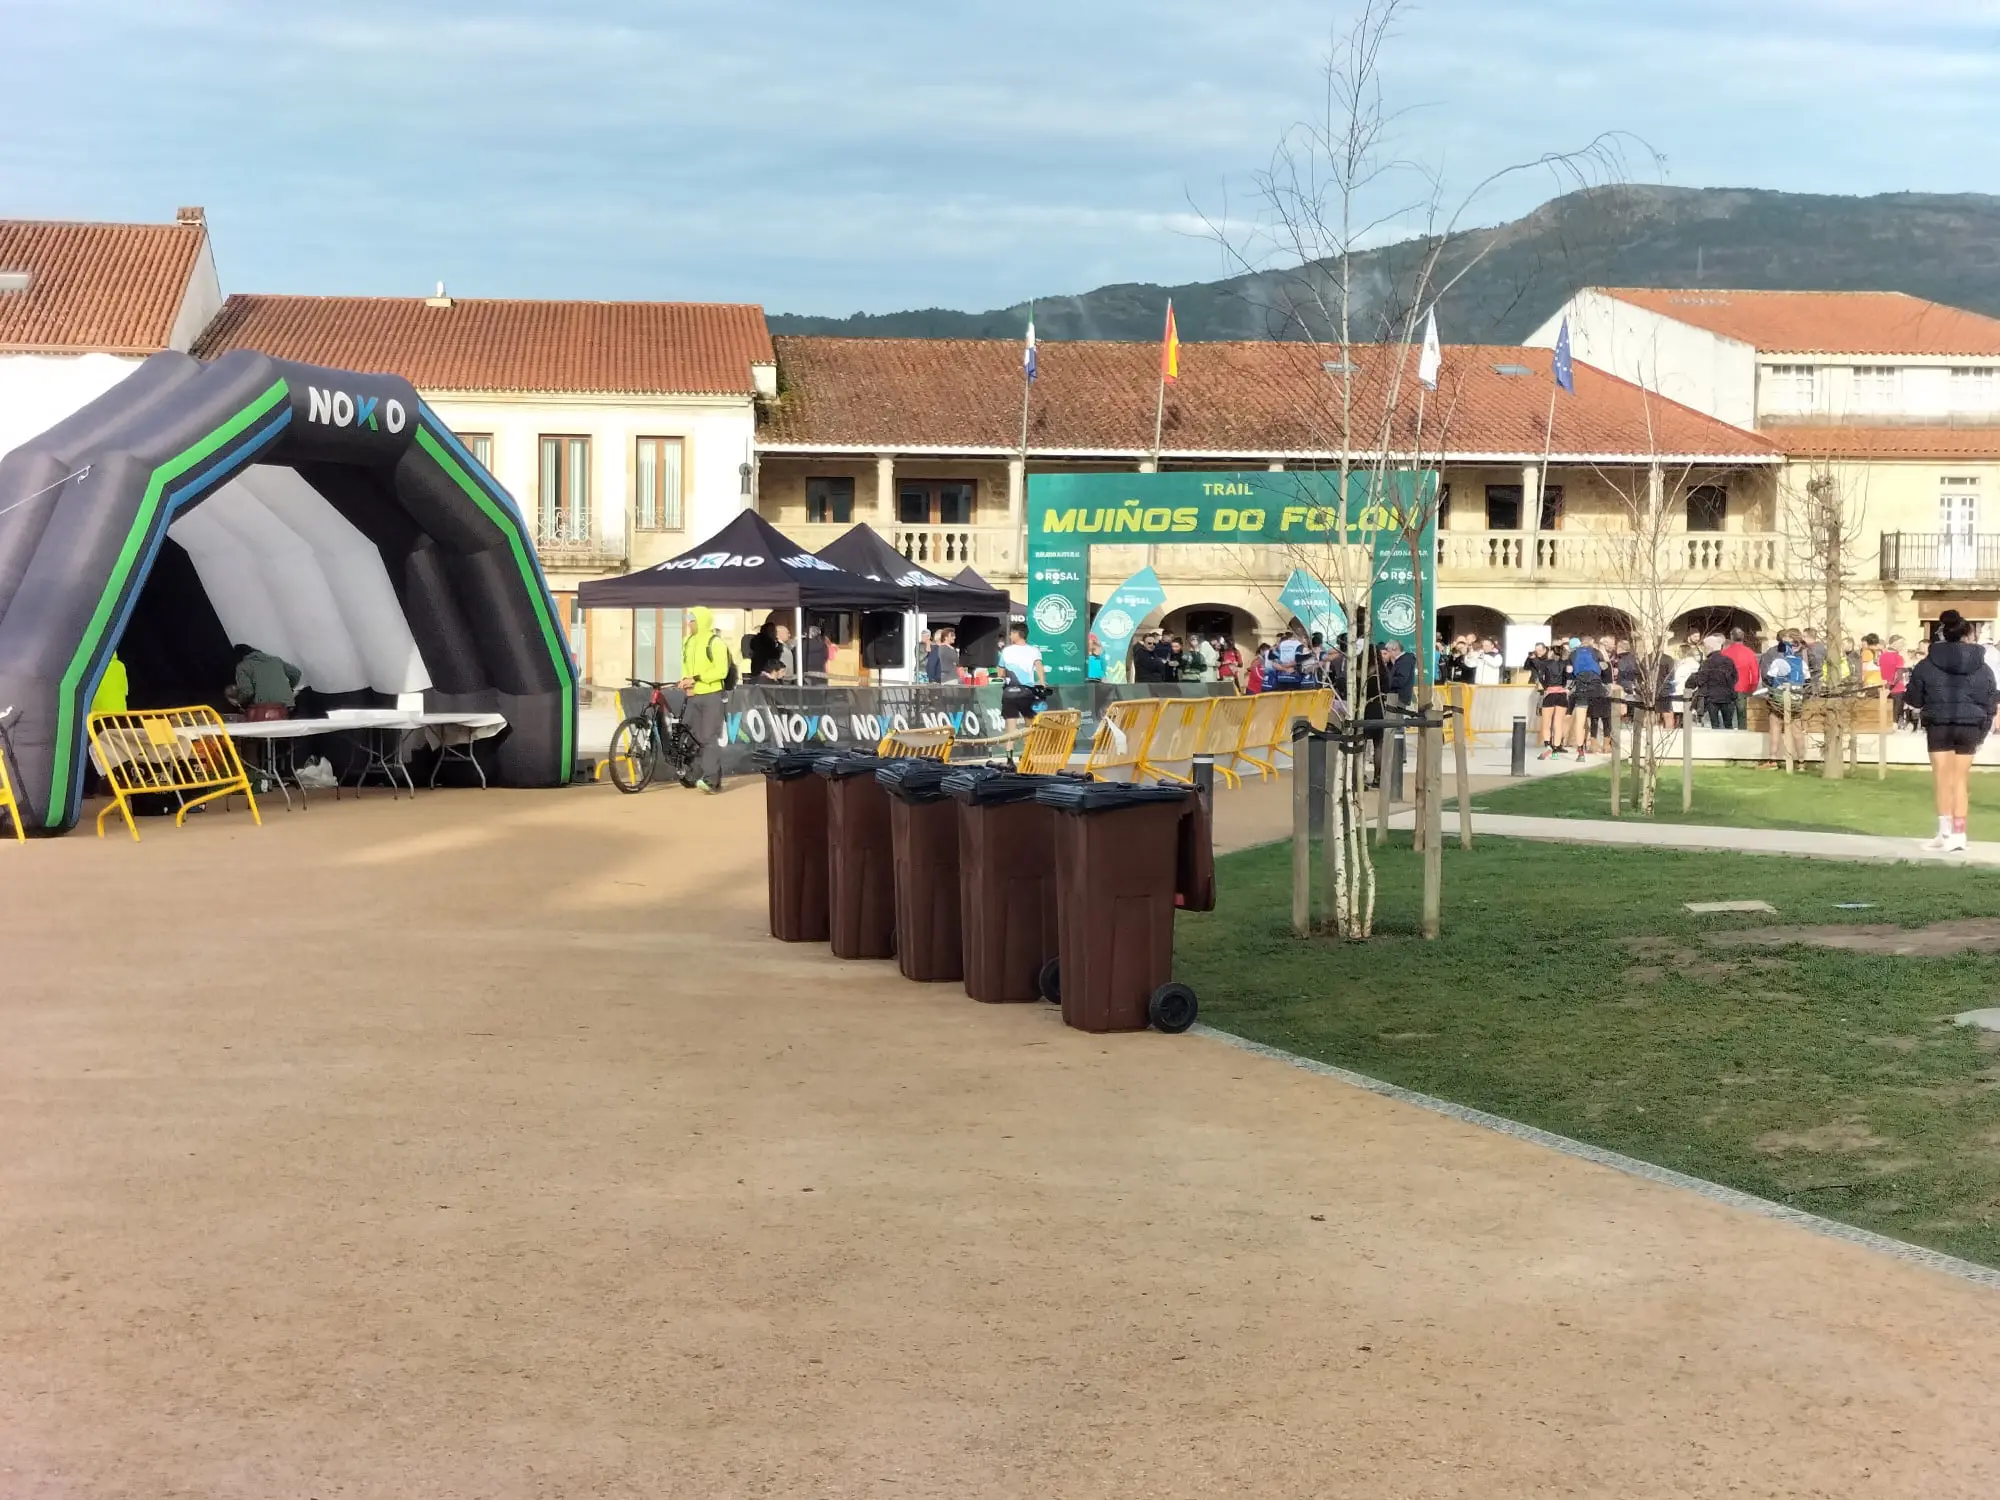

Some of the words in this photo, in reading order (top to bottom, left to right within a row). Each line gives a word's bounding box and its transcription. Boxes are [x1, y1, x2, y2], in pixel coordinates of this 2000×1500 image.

[1203, 483, 1254, 496] TRAIL
[1042, 499, 1199, 533] MUIÑOS
[1213, 508, 1266, 532] DO
[656, 552, 765, 571] NOKAO
